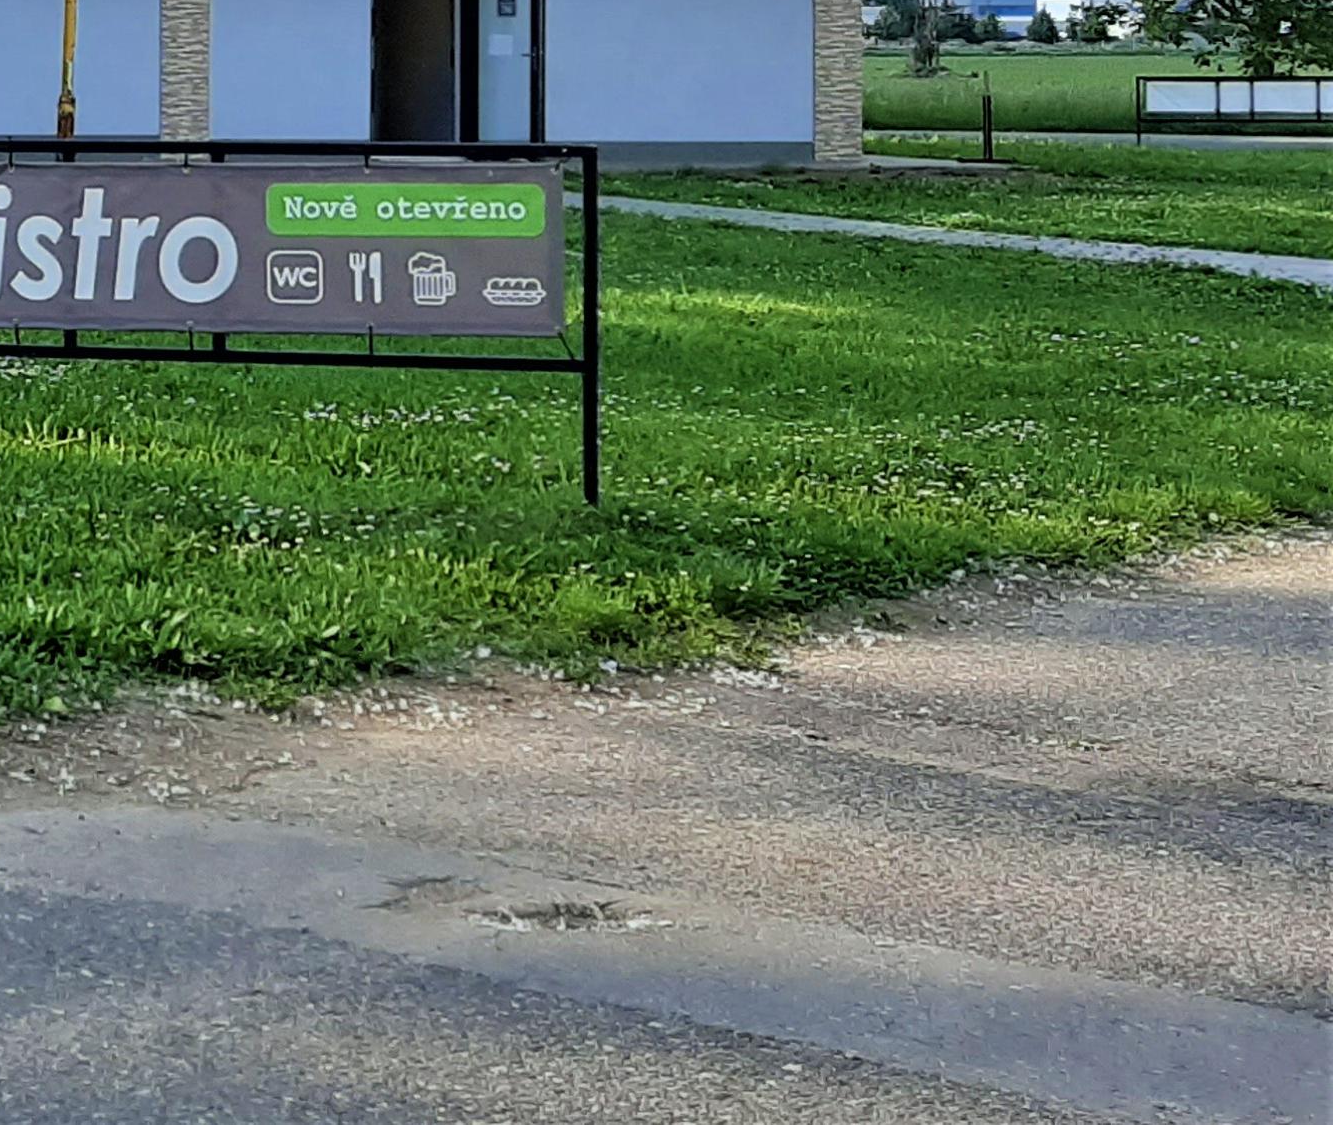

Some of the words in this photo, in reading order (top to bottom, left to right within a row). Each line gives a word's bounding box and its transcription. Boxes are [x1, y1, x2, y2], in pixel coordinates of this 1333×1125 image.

[283, 195, 358, 219] Nově
[376, 195, 527, 220] otevřeno
[272, 266, 318, 288] WC
